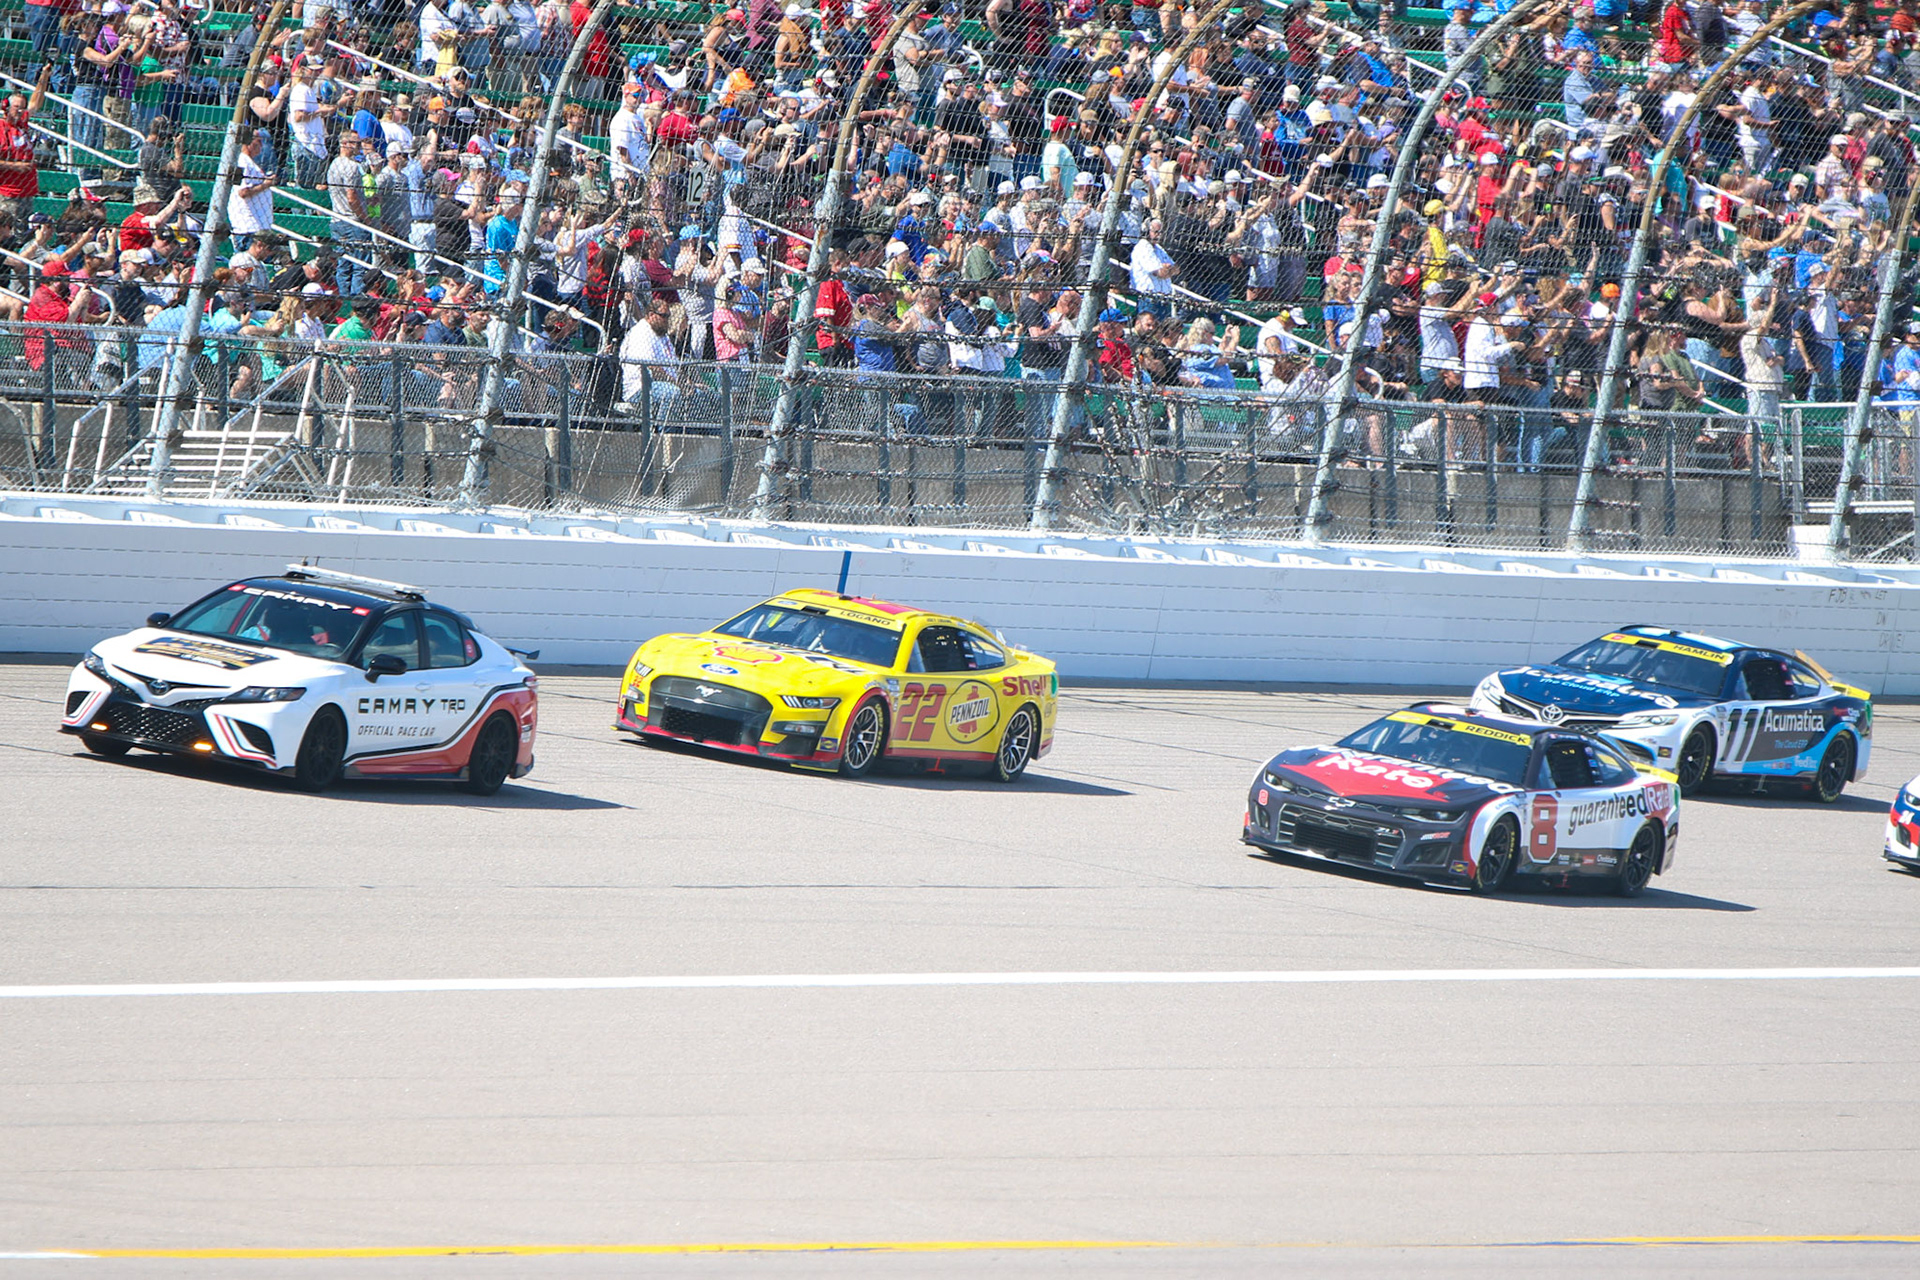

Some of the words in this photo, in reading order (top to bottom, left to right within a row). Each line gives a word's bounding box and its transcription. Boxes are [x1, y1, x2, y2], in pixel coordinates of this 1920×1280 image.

[689, 171, 703, 202] 12
[840, 611, 890, 625] LOGANO
[1673, 645, 1725, 660] HAMLIN
[1002, 675, 1046, 697] Shell
[894, 682, 947, 742] 22
[950, 698, 990, 725] PENNZOIL
[1764, 709, 1826, 732] Acumatica
[357, 725, 394, 736] OFFICIAL
[397, 726, 418, 737] PACE
[419, 727, 436, 737] CAR
[1465, 725, 1526, 744] REDDICK
[1719, 707, 1760, 763] 11
[1316, 754, 1433, 788] Rate
[1259, 789, 1268, 805] 8
[1568, 787, 1648, 836] guaranteed
[1648, 786, 1669, 812] Rate
[1528, 793, 1558, 863] 8
